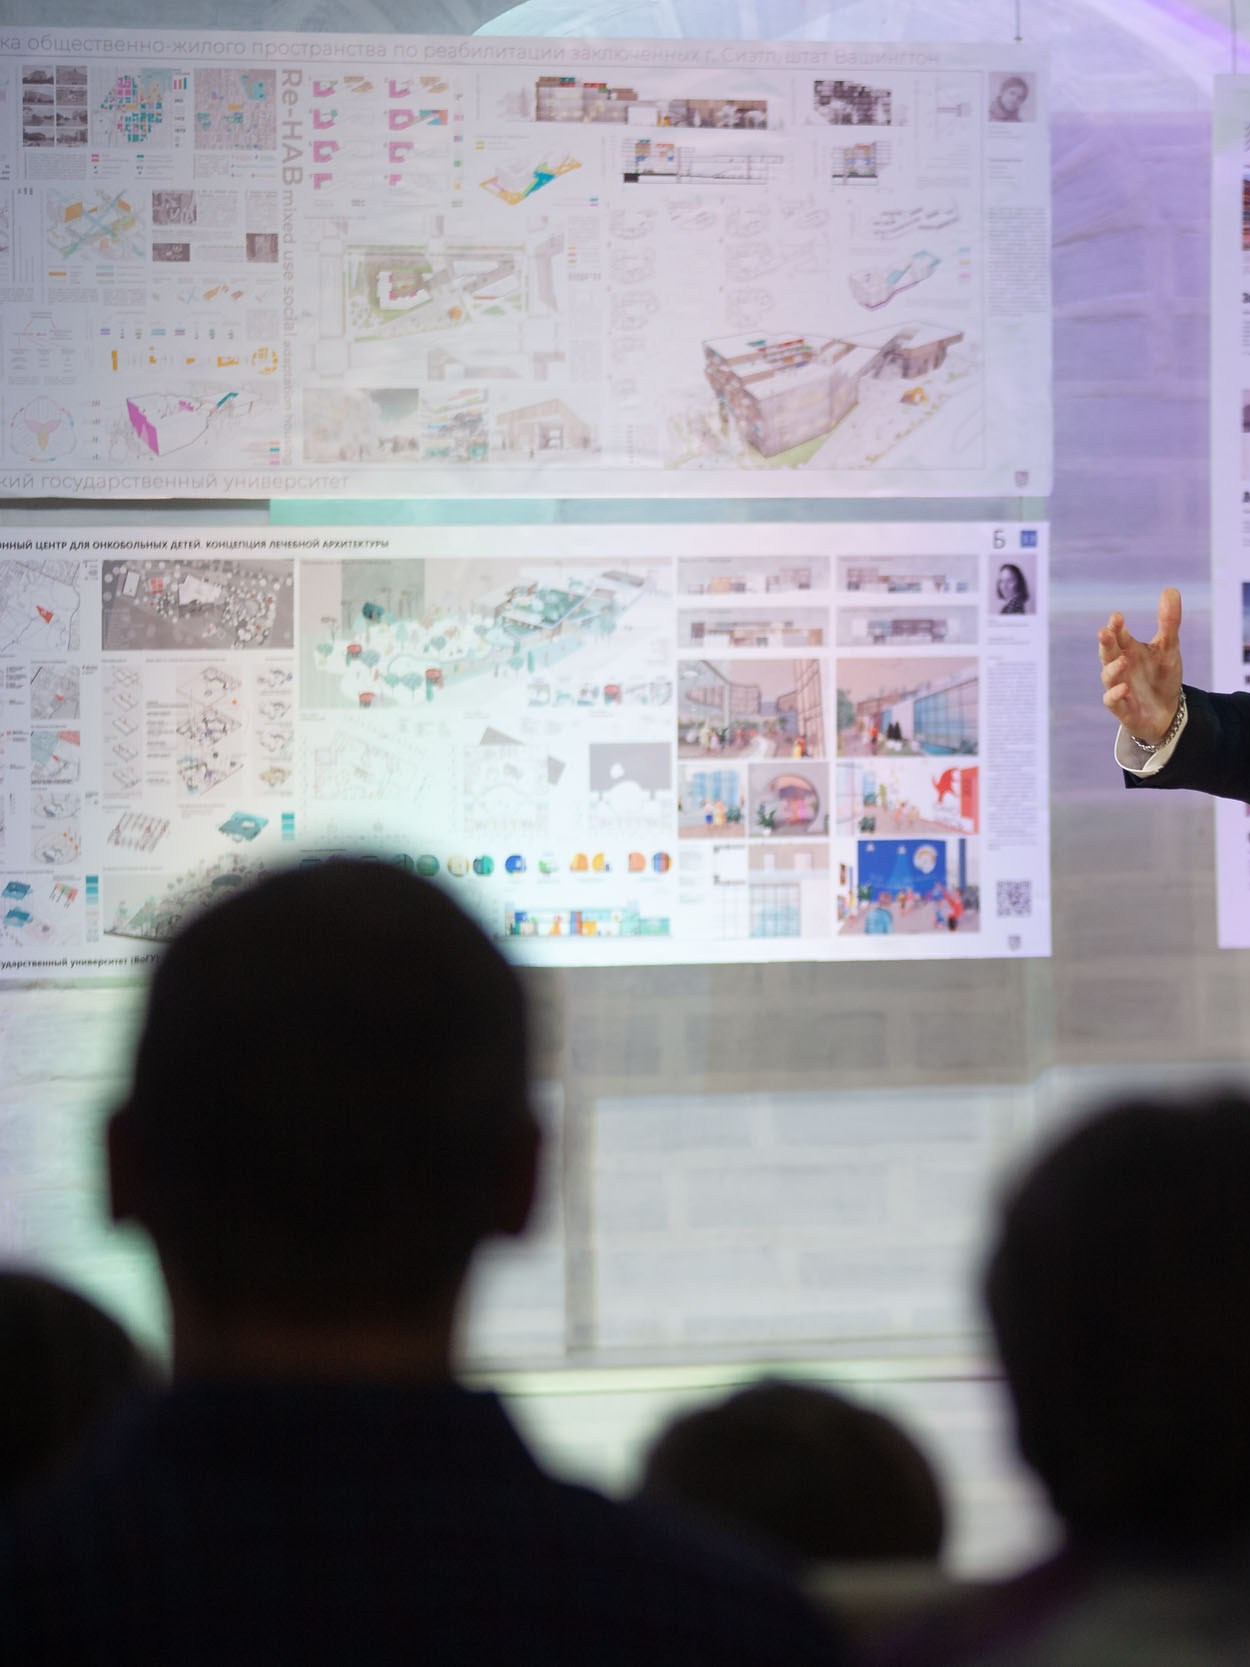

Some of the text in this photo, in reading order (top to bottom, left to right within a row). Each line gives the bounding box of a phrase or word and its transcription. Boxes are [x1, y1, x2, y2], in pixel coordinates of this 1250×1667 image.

[0, 36, 21, 50] ка
[27, 34, 246, 55] общественно-жилого
[252, 40, 387, 59] пространства
[395, 43, 417, 57] по
[424, 42, 565, 62] реабилитации
[570, 47, 700, 64] заключенных
[785, 49, 829, 65] штат
[835, 48, 940, 66] Вашингтон
[281, 68, 304, 186] Re-HAB
[282, 190, 297, 244] mixed
[282, 250, 295, 281] use
[282, 286, 298, 337] social
[41, 473, 217, 494] государственный
[224, 475, 350, 493] университет
[36, 540, 67, 552] ЦЕНТР
[69, 540, 90, 552] ДЛЯ
[92, 540, 168, 551] ОНКОБОЛЬНЫХ
[206, 540, 267, 552] КОНЦЕПЦИЯ
[269, 538, 320, 551] ЛЕЧЕБНОЙ
[322, 539, 390, 551] АРХИТЕКТУРЫ
[70, 956, 128, 969] университет
